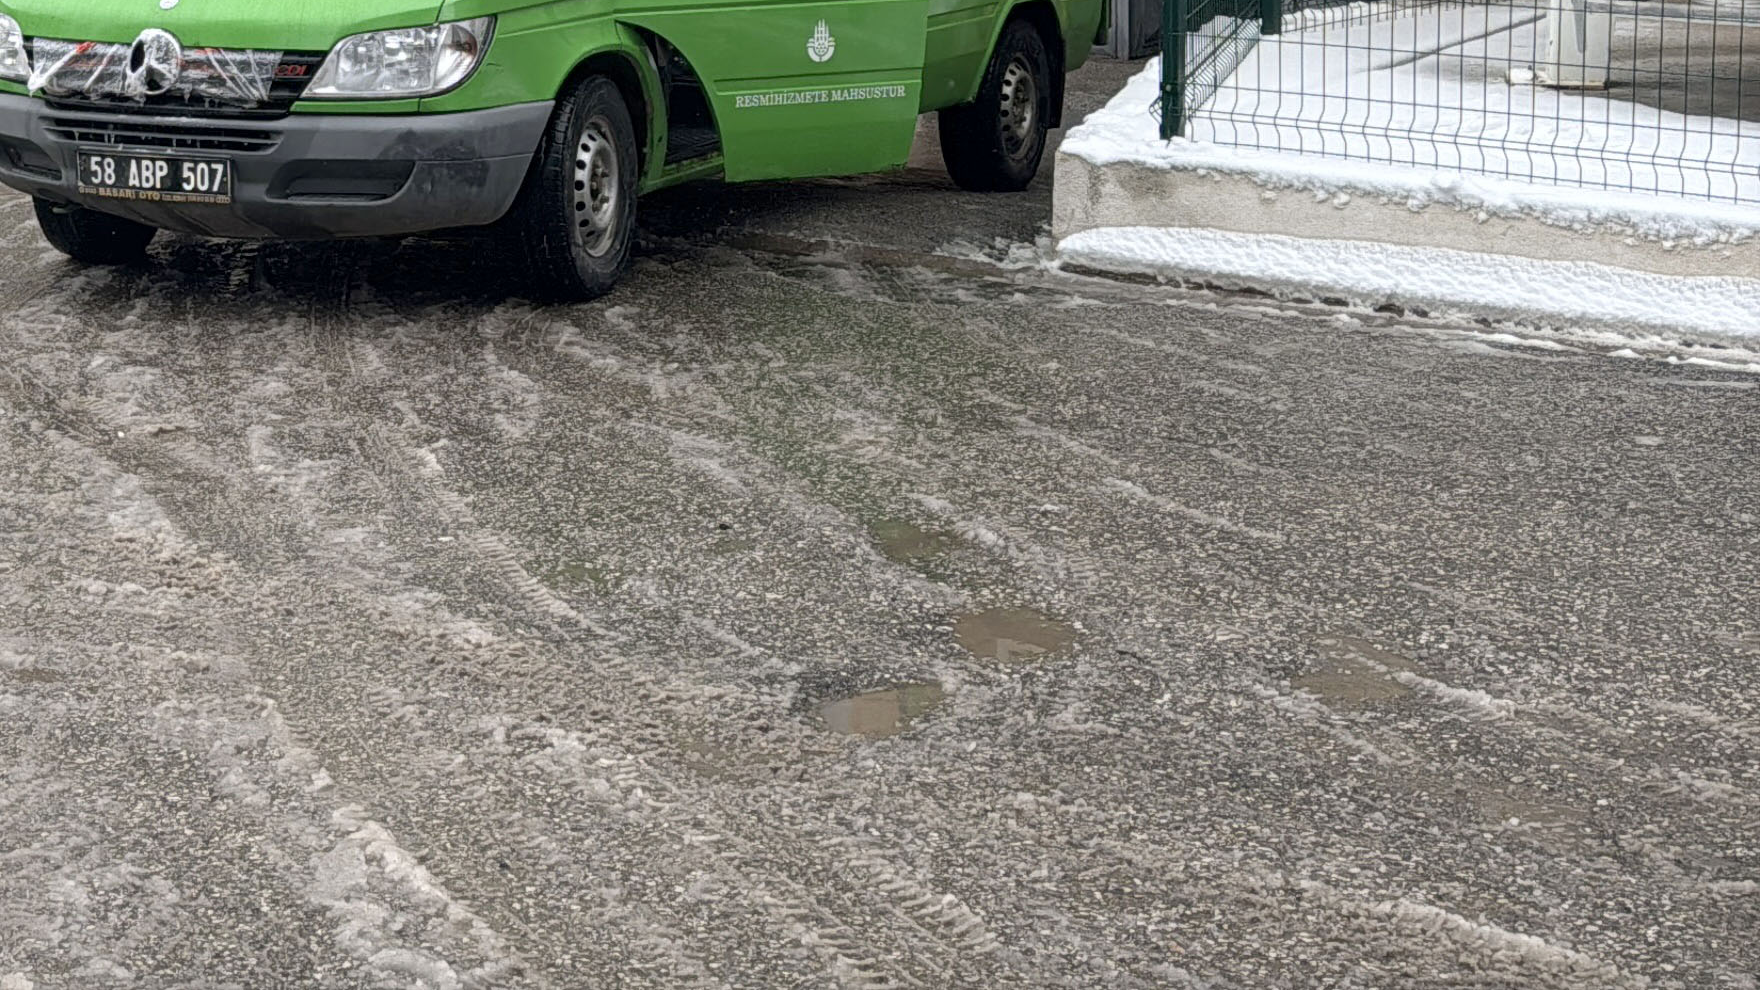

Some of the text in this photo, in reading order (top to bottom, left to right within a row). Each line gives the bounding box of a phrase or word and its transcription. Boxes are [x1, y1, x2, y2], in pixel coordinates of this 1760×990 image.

[831, 85, 906, 101] MAHSUSTUR
[90, 156, 224, 192] 58 ABP 507
